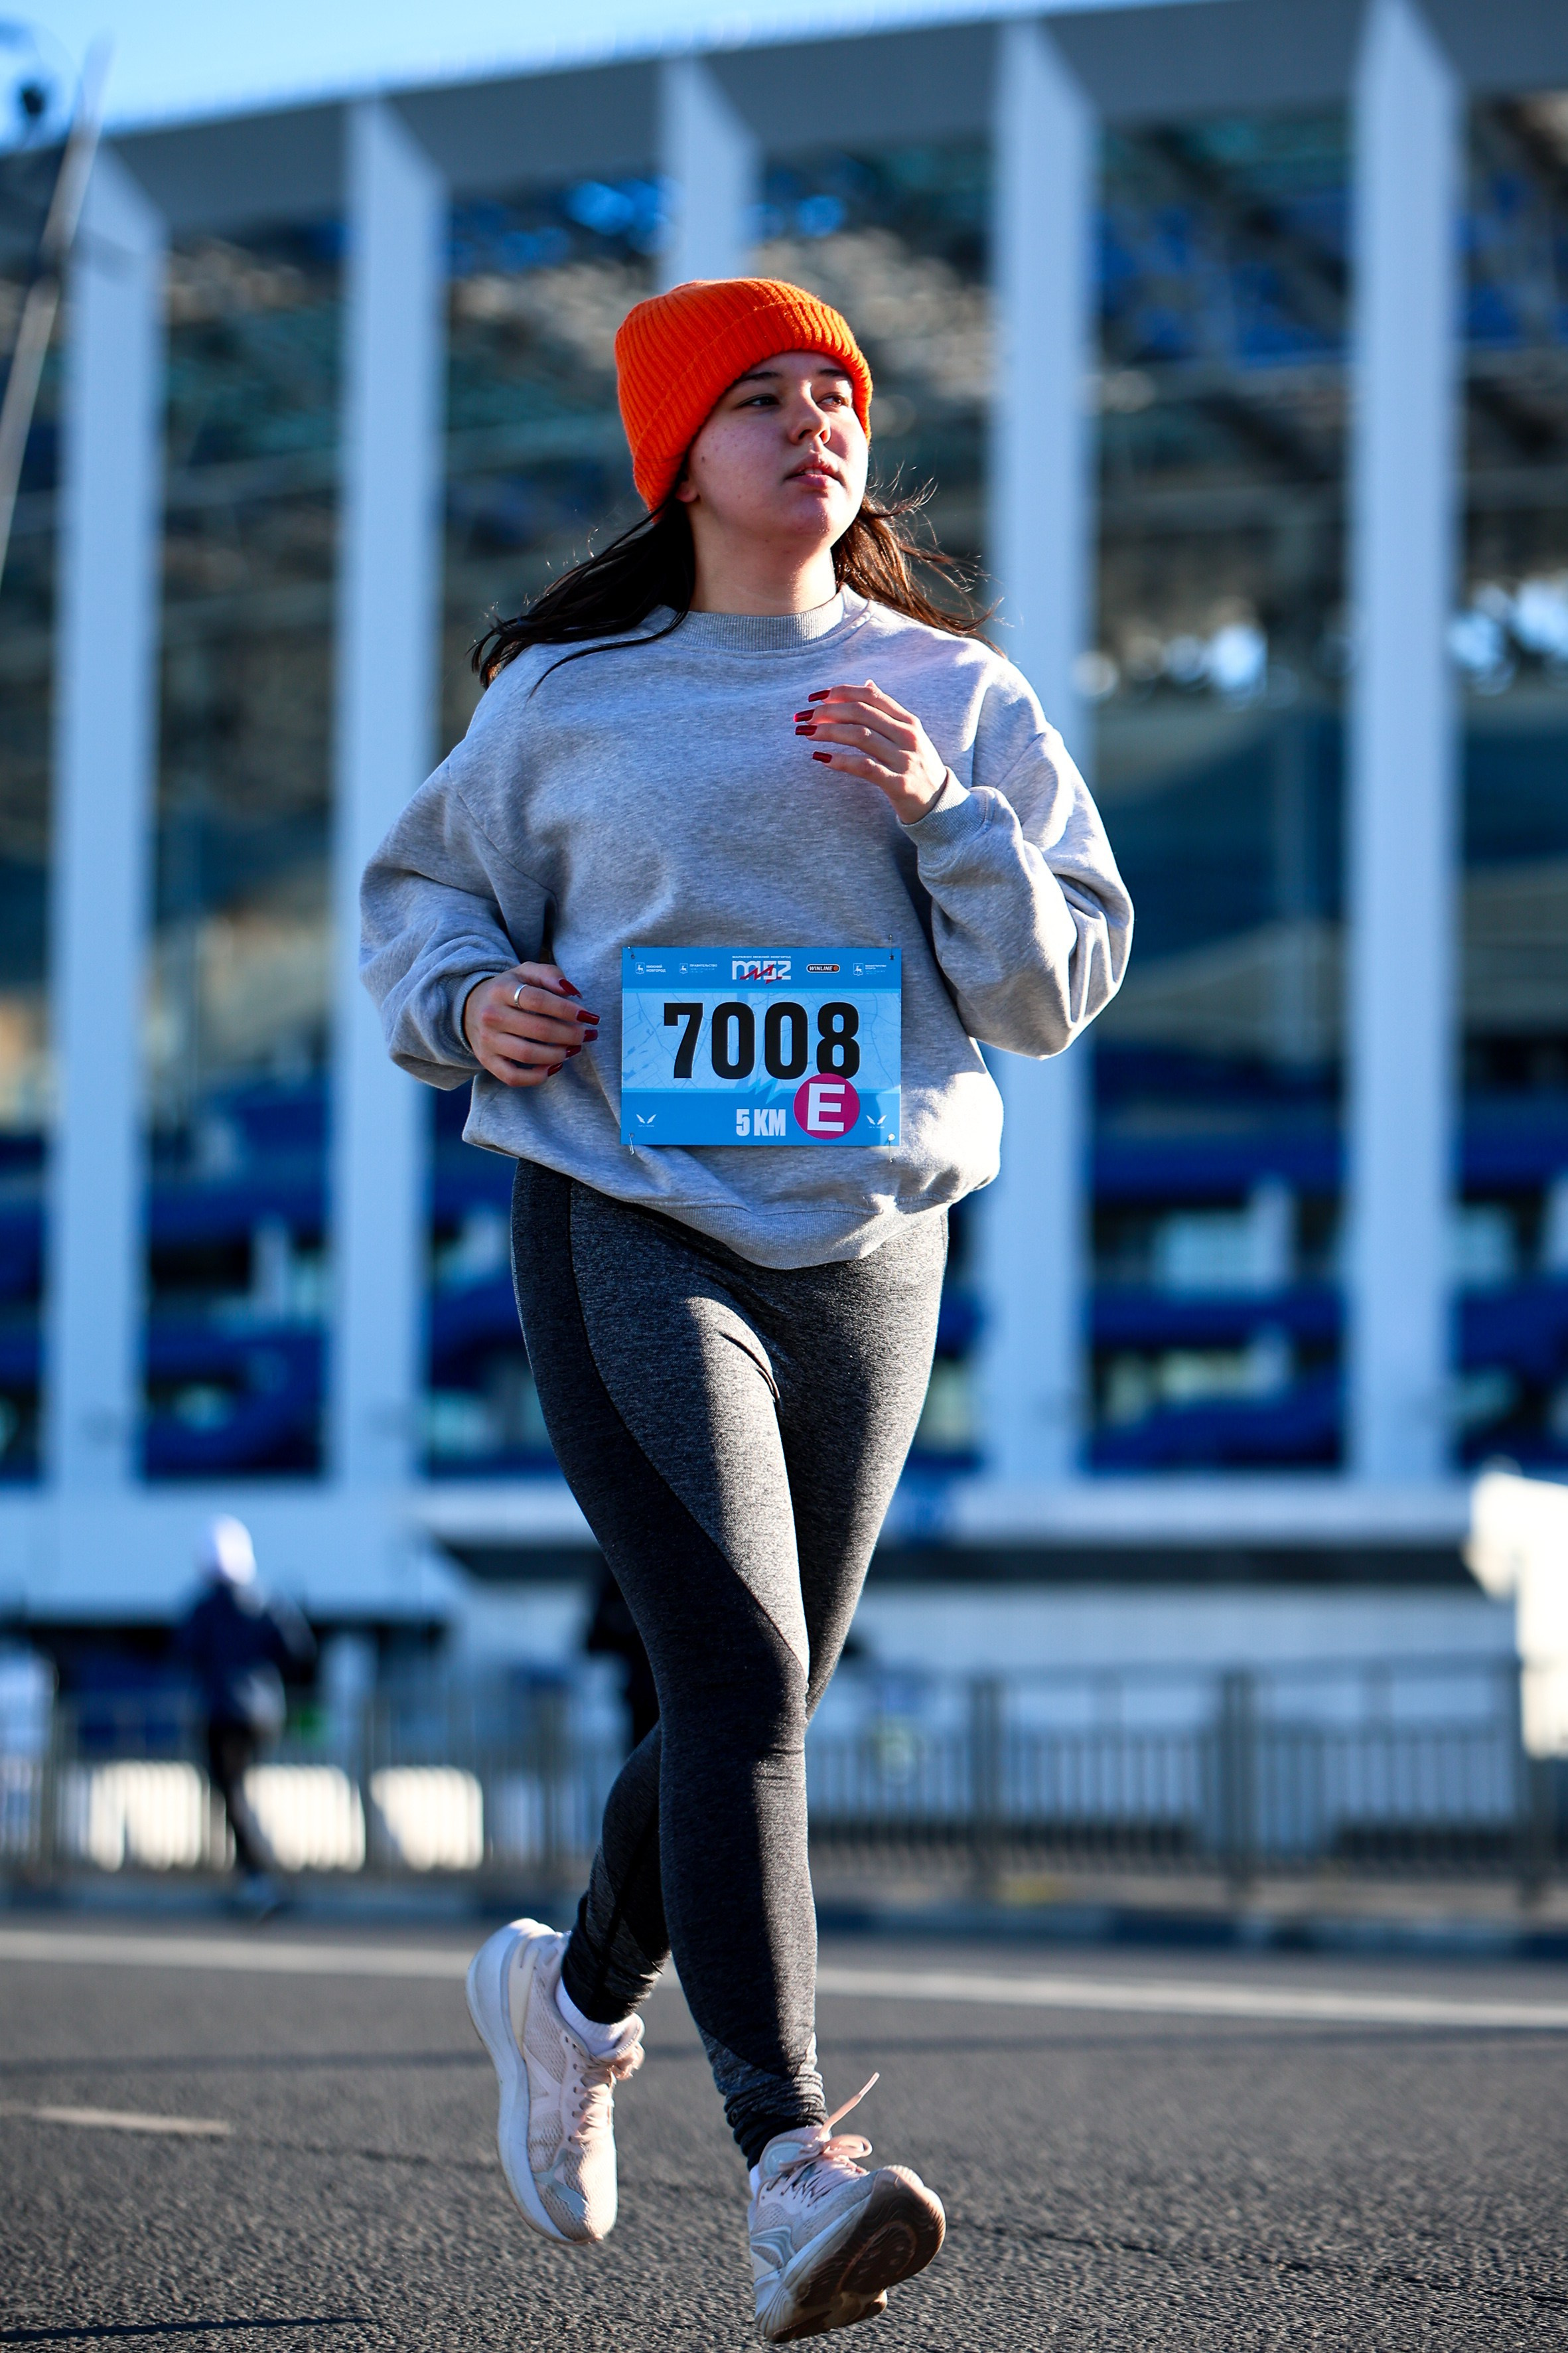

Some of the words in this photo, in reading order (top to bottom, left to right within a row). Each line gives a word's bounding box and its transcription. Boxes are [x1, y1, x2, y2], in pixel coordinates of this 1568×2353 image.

[664, 1002, 861, 1080] 7008
[736, 1108, 750, 1136] 5
[807, 1083, 845, 1132] E
